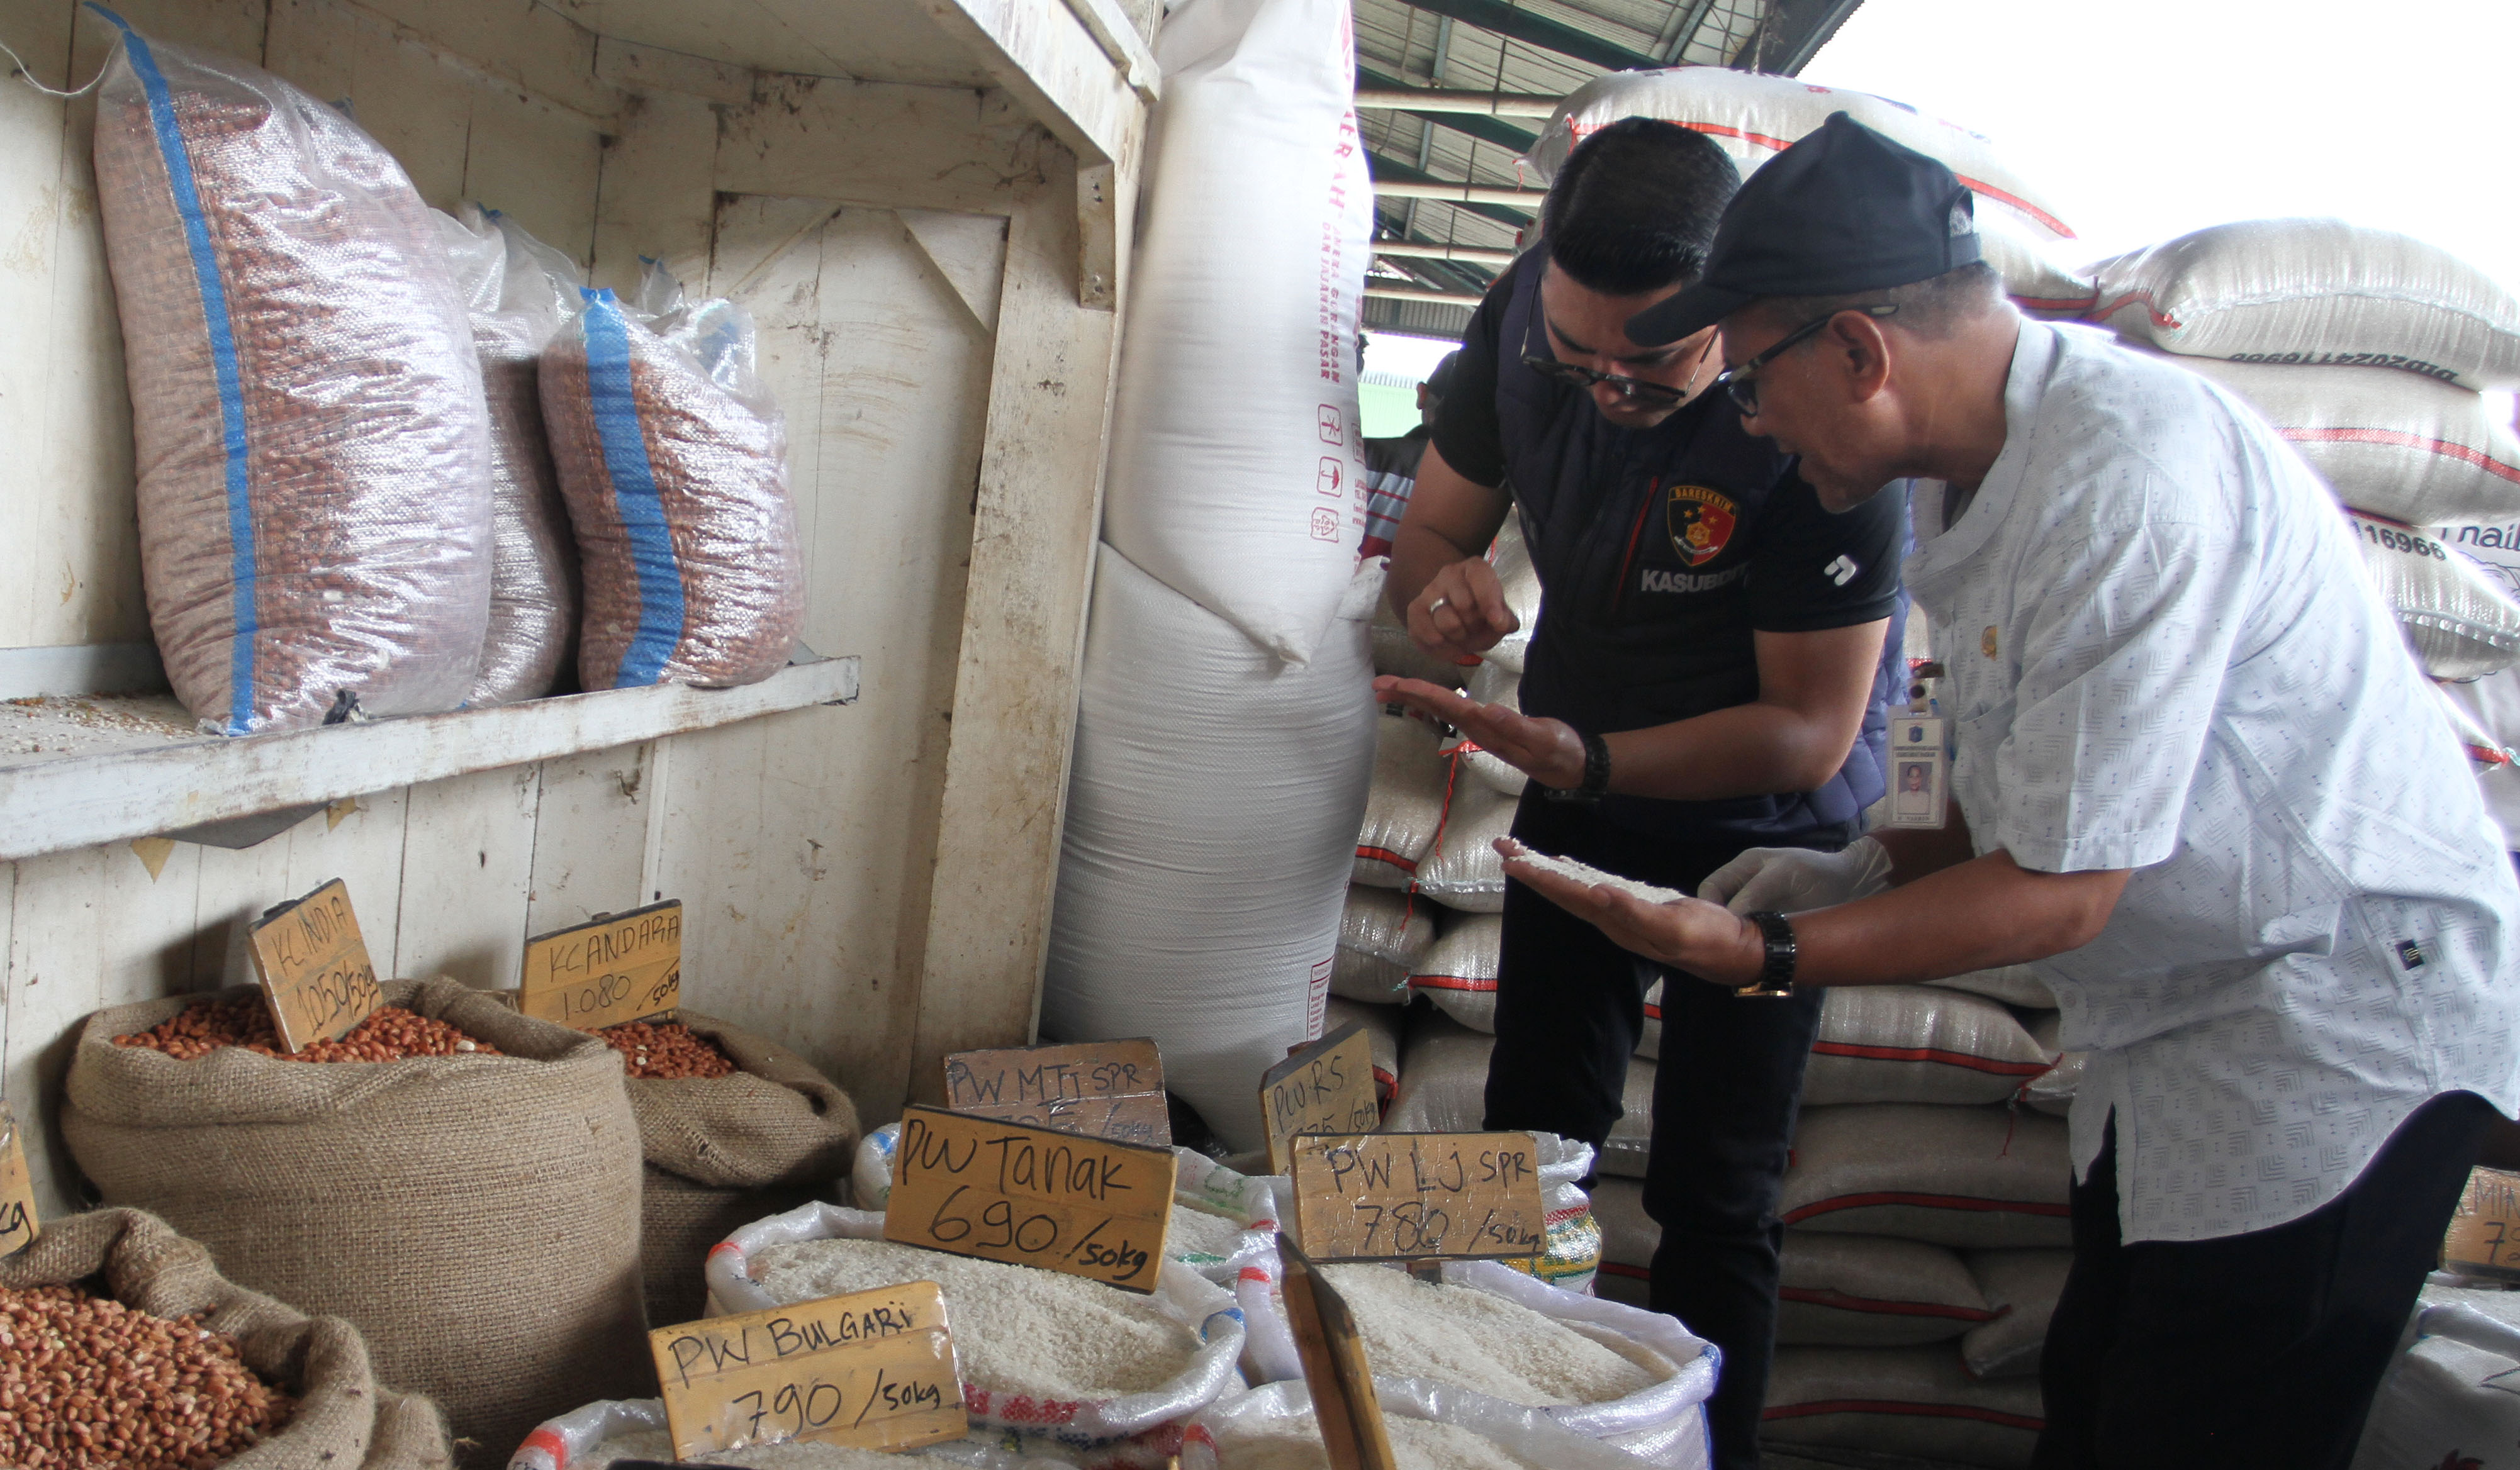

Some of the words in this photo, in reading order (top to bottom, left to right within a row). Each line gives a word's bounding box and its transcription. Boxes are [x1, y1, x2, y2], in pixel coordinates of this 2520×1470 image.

[1319, 330, 1330, 379] PASAR
[1674, 487, 1733, 513] BARESKRIM
[298, 896, 348, 954] INDIA
[946, 1060, 1005, 1104] PW
[1091, 1062, 1143, 1091] SPR
[902, 1118, 978, 1186] PW
[985, 1136, 1132, 1200] Tanak
[1326, 1146, 1391, 1194] PW
[1479, 1150, 1532, 1188] SPR
[1354, 1201, 1449, 1252] 780
[668, 1335, 751, 1389] PW
[731, 1381, 843, 1442] 790
